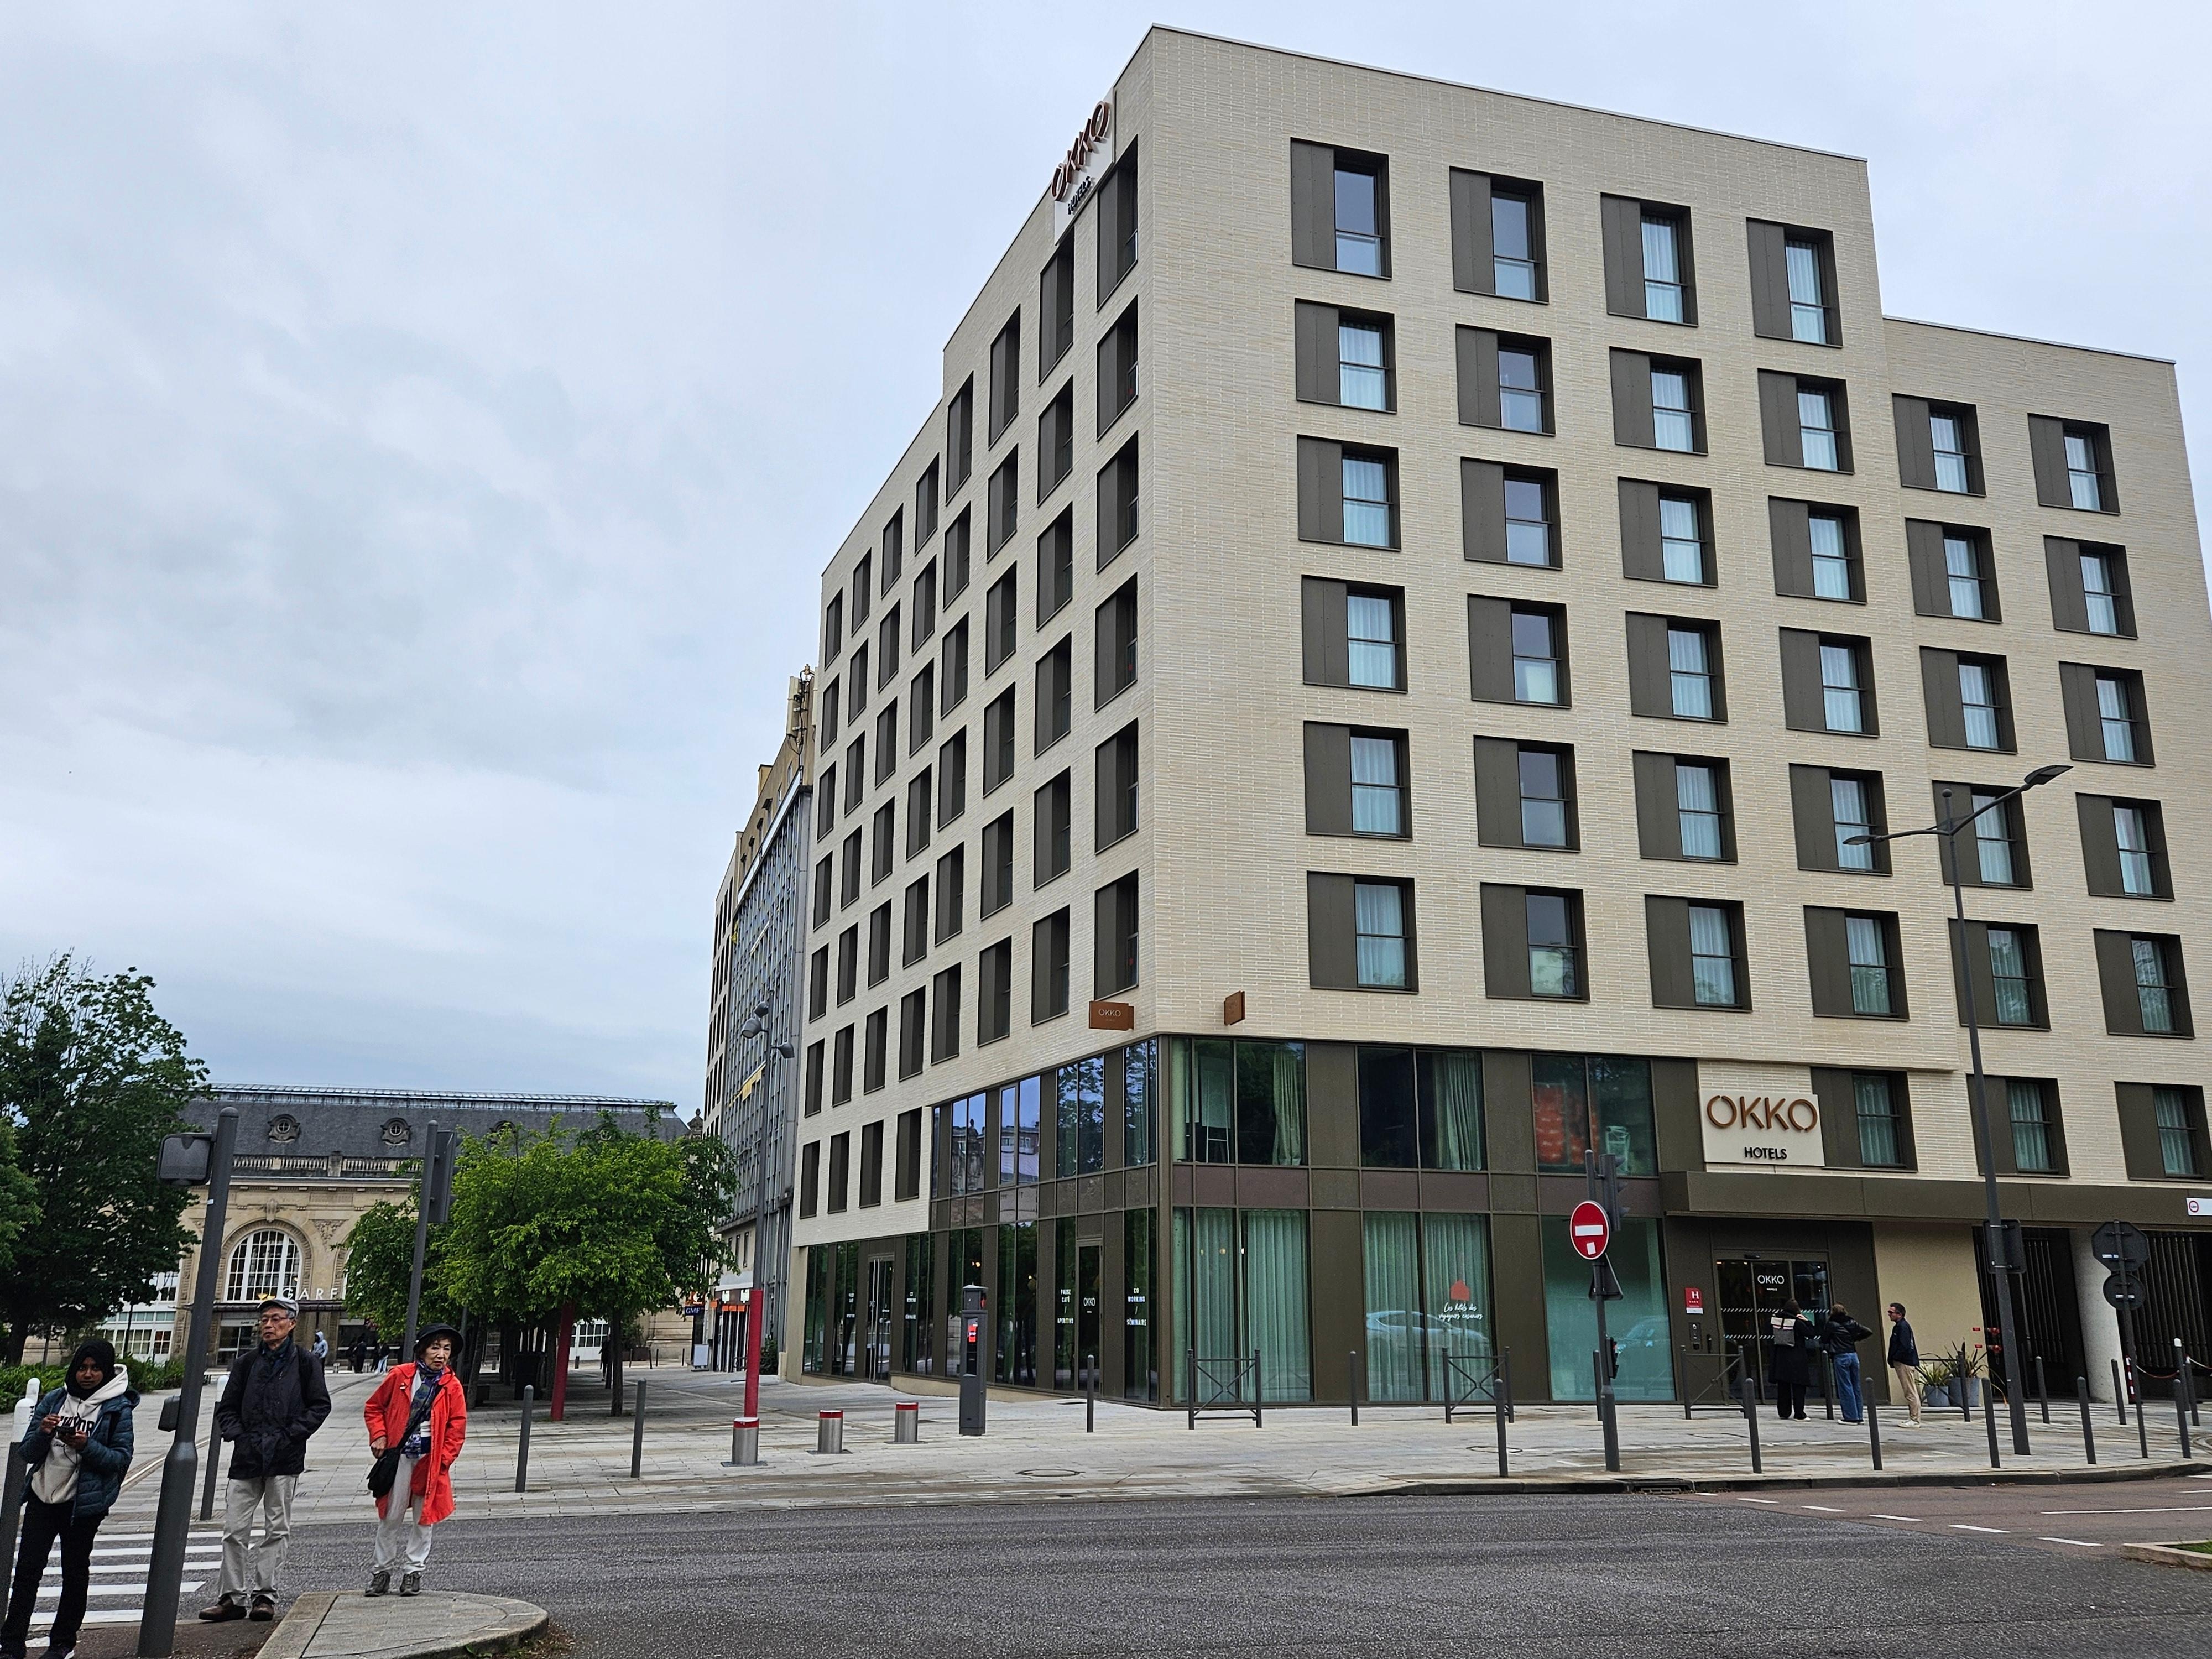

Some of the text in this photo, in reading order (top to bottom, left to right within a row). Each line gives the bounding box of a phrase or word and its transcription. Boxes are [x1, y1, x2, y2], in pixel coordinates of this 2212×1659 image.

[1051, 100, 1110, 201] OKKO
[1098, 1009, 1121, 1017] OKKO
[1707, 1095, 1818, 1133] OKKO
[1744, 1146, 1788, 1160] HOTELS
[1757, 1275, 1785, 1285] OKKO
[1692, 1291, 1699, 1300] H
